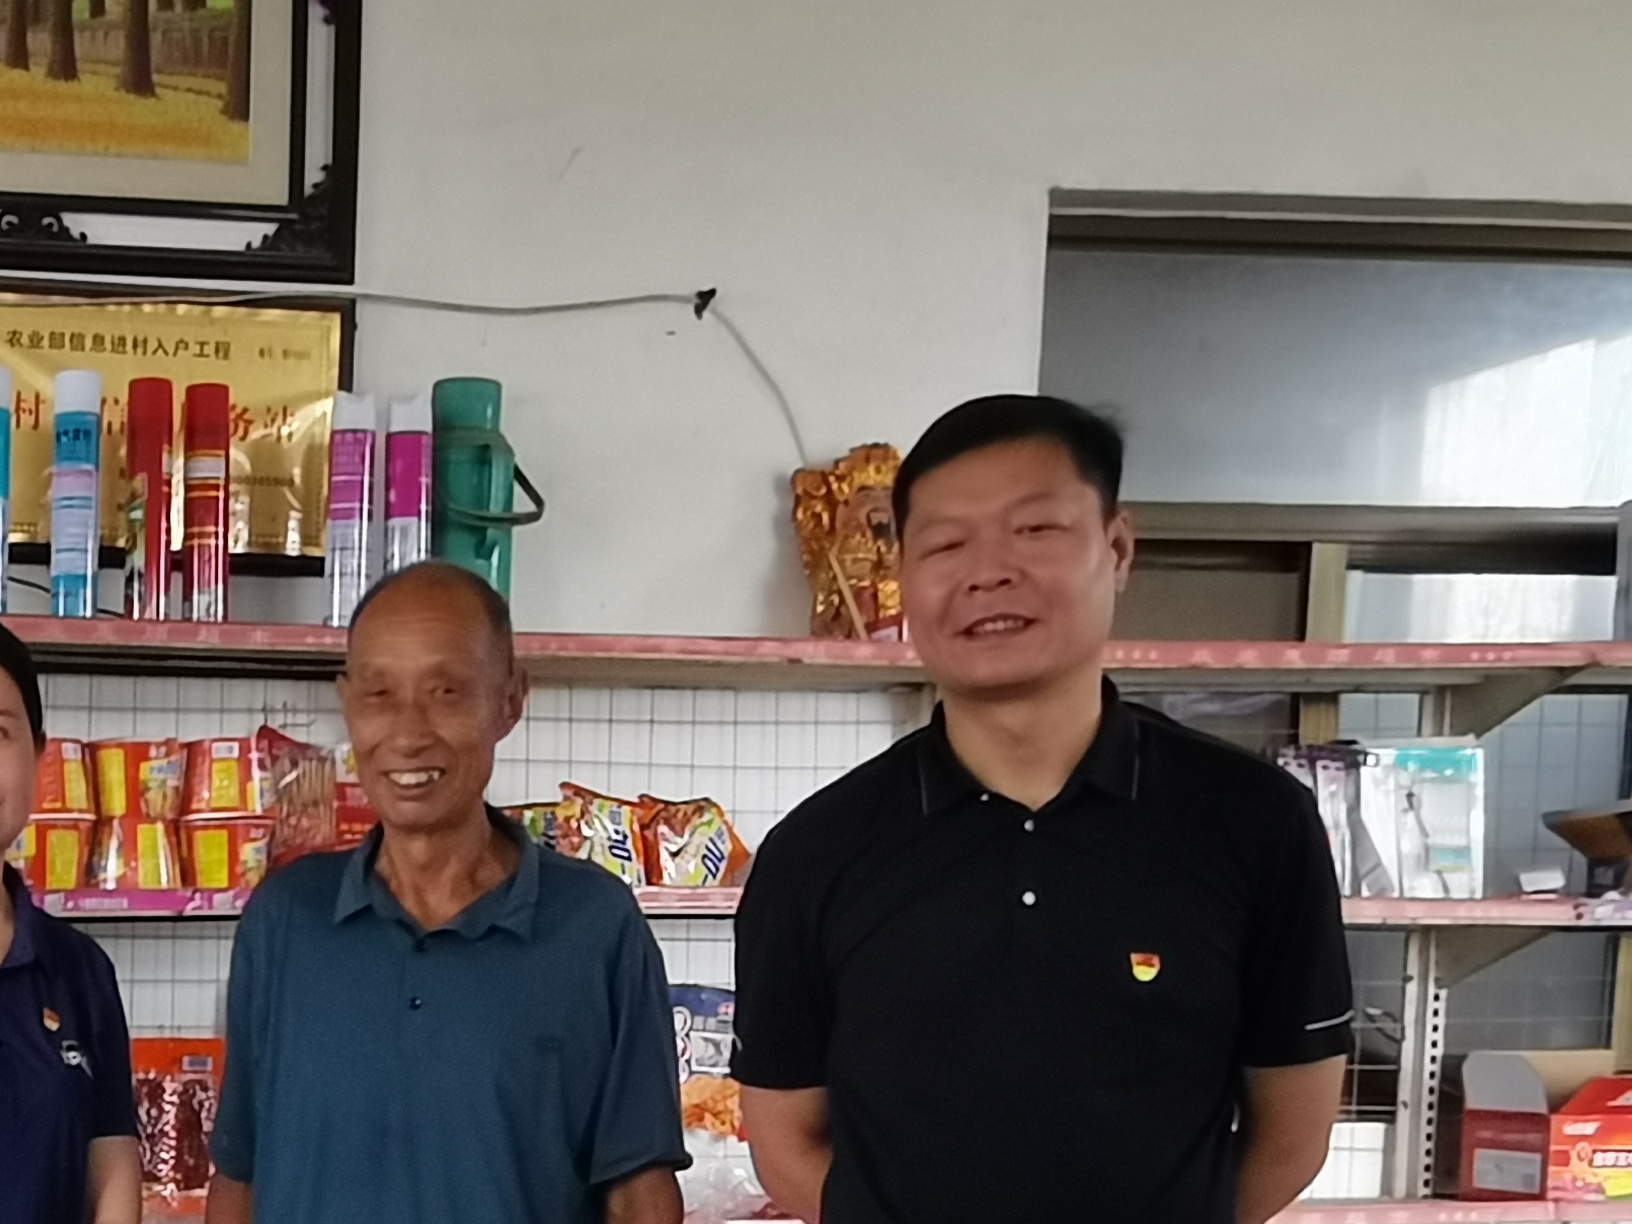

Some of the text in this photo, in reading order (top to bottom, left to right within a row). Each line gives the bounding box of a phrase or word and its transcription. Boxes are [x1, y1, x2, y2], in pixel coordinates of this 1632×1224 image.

[5, 328, 231, 361] 农业部信息进村入户工程
